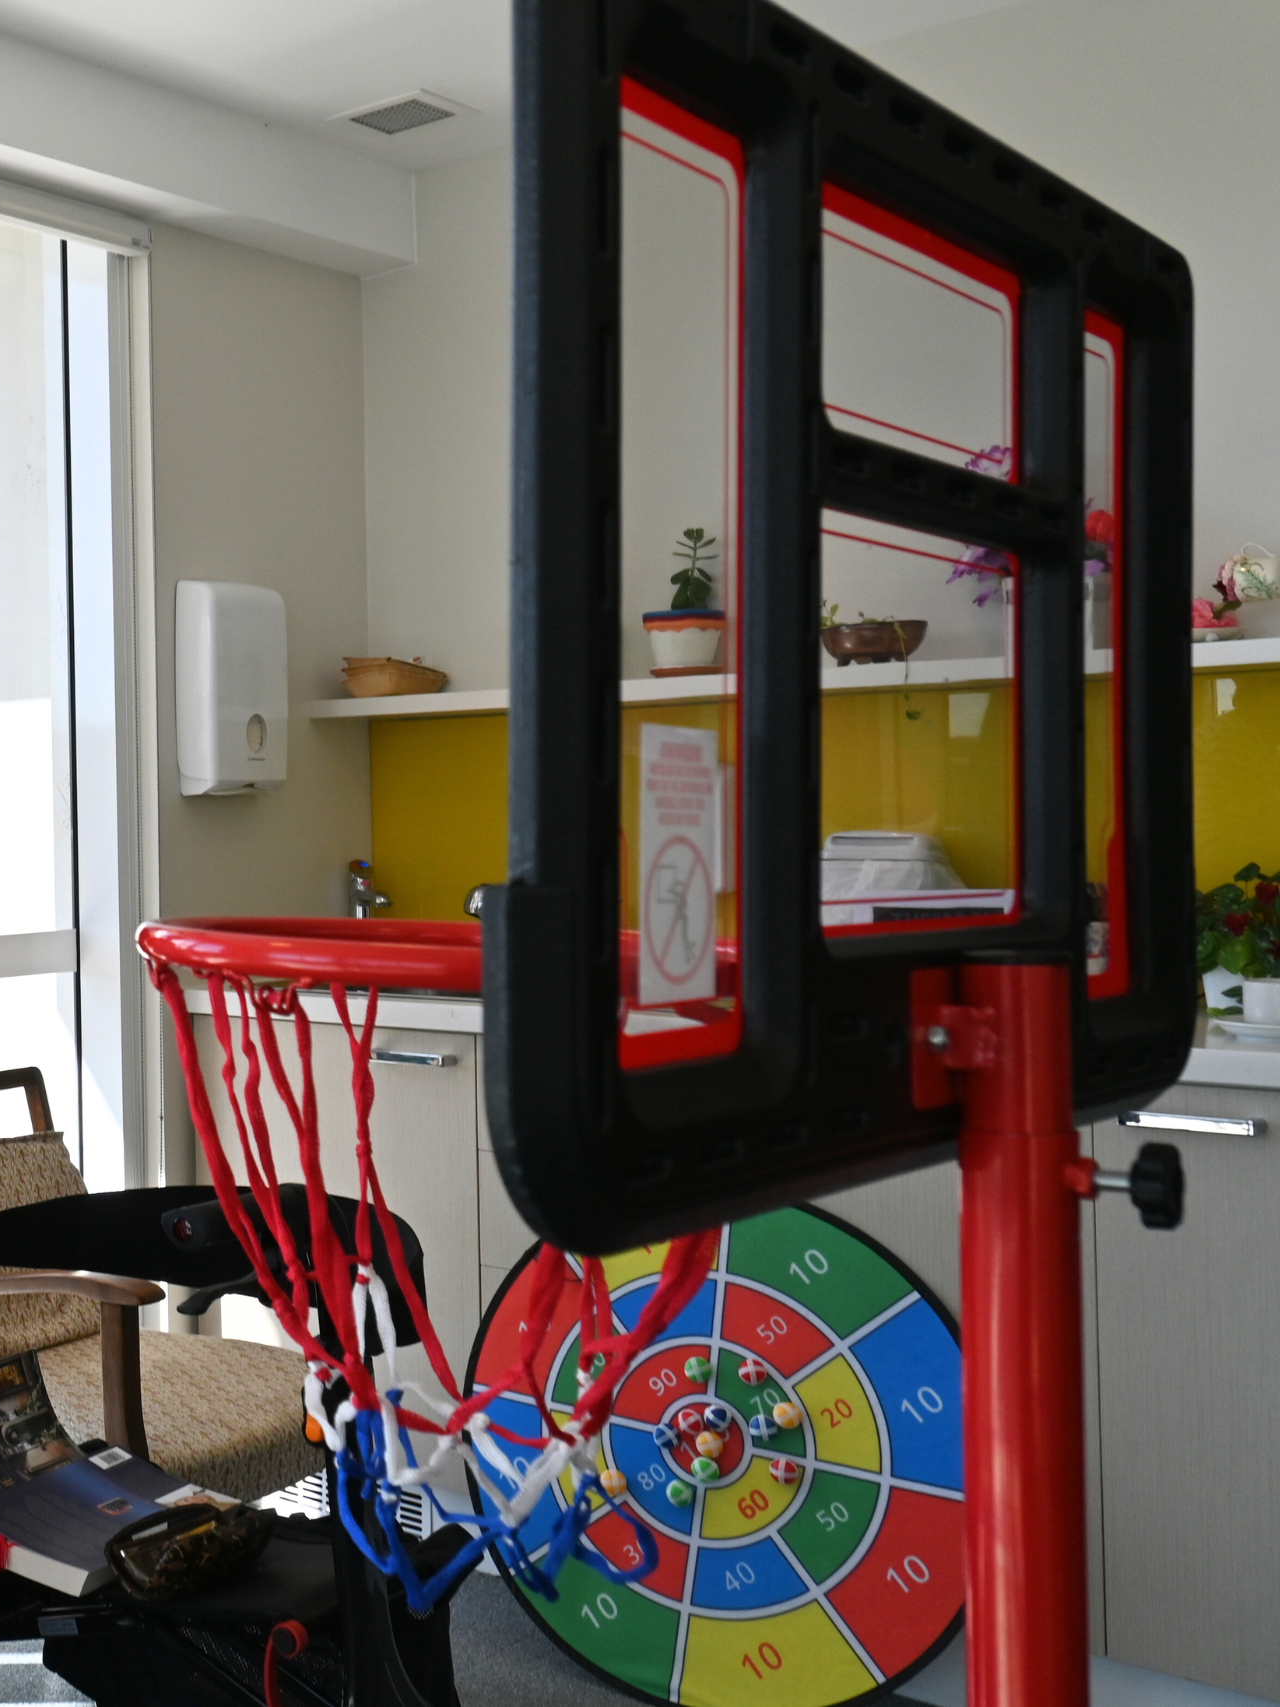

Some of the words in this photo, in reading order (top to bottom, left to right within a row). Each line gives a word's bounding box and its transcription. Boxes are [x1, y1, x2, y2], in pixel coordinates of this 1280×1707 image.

[789, 1249, 829, 1285] 10
[756, 1315, 788, 1345] 50
[648, 1368, 677, 1397] 90
[820, 1398, 853, 1429] 20
[900, 1386, 943, 1424] 10
[637, 1463, 666, 1491] 80
[737, 1489, 770, 1520] 60
[815, 1501, 850, 1533] 50
[724, 1561, 756, 1592] 40
[886, 1554, 930, 1594] 10
[581, 1591, 618, 1630] 10
[742, 1641, 783, 1679] 10
